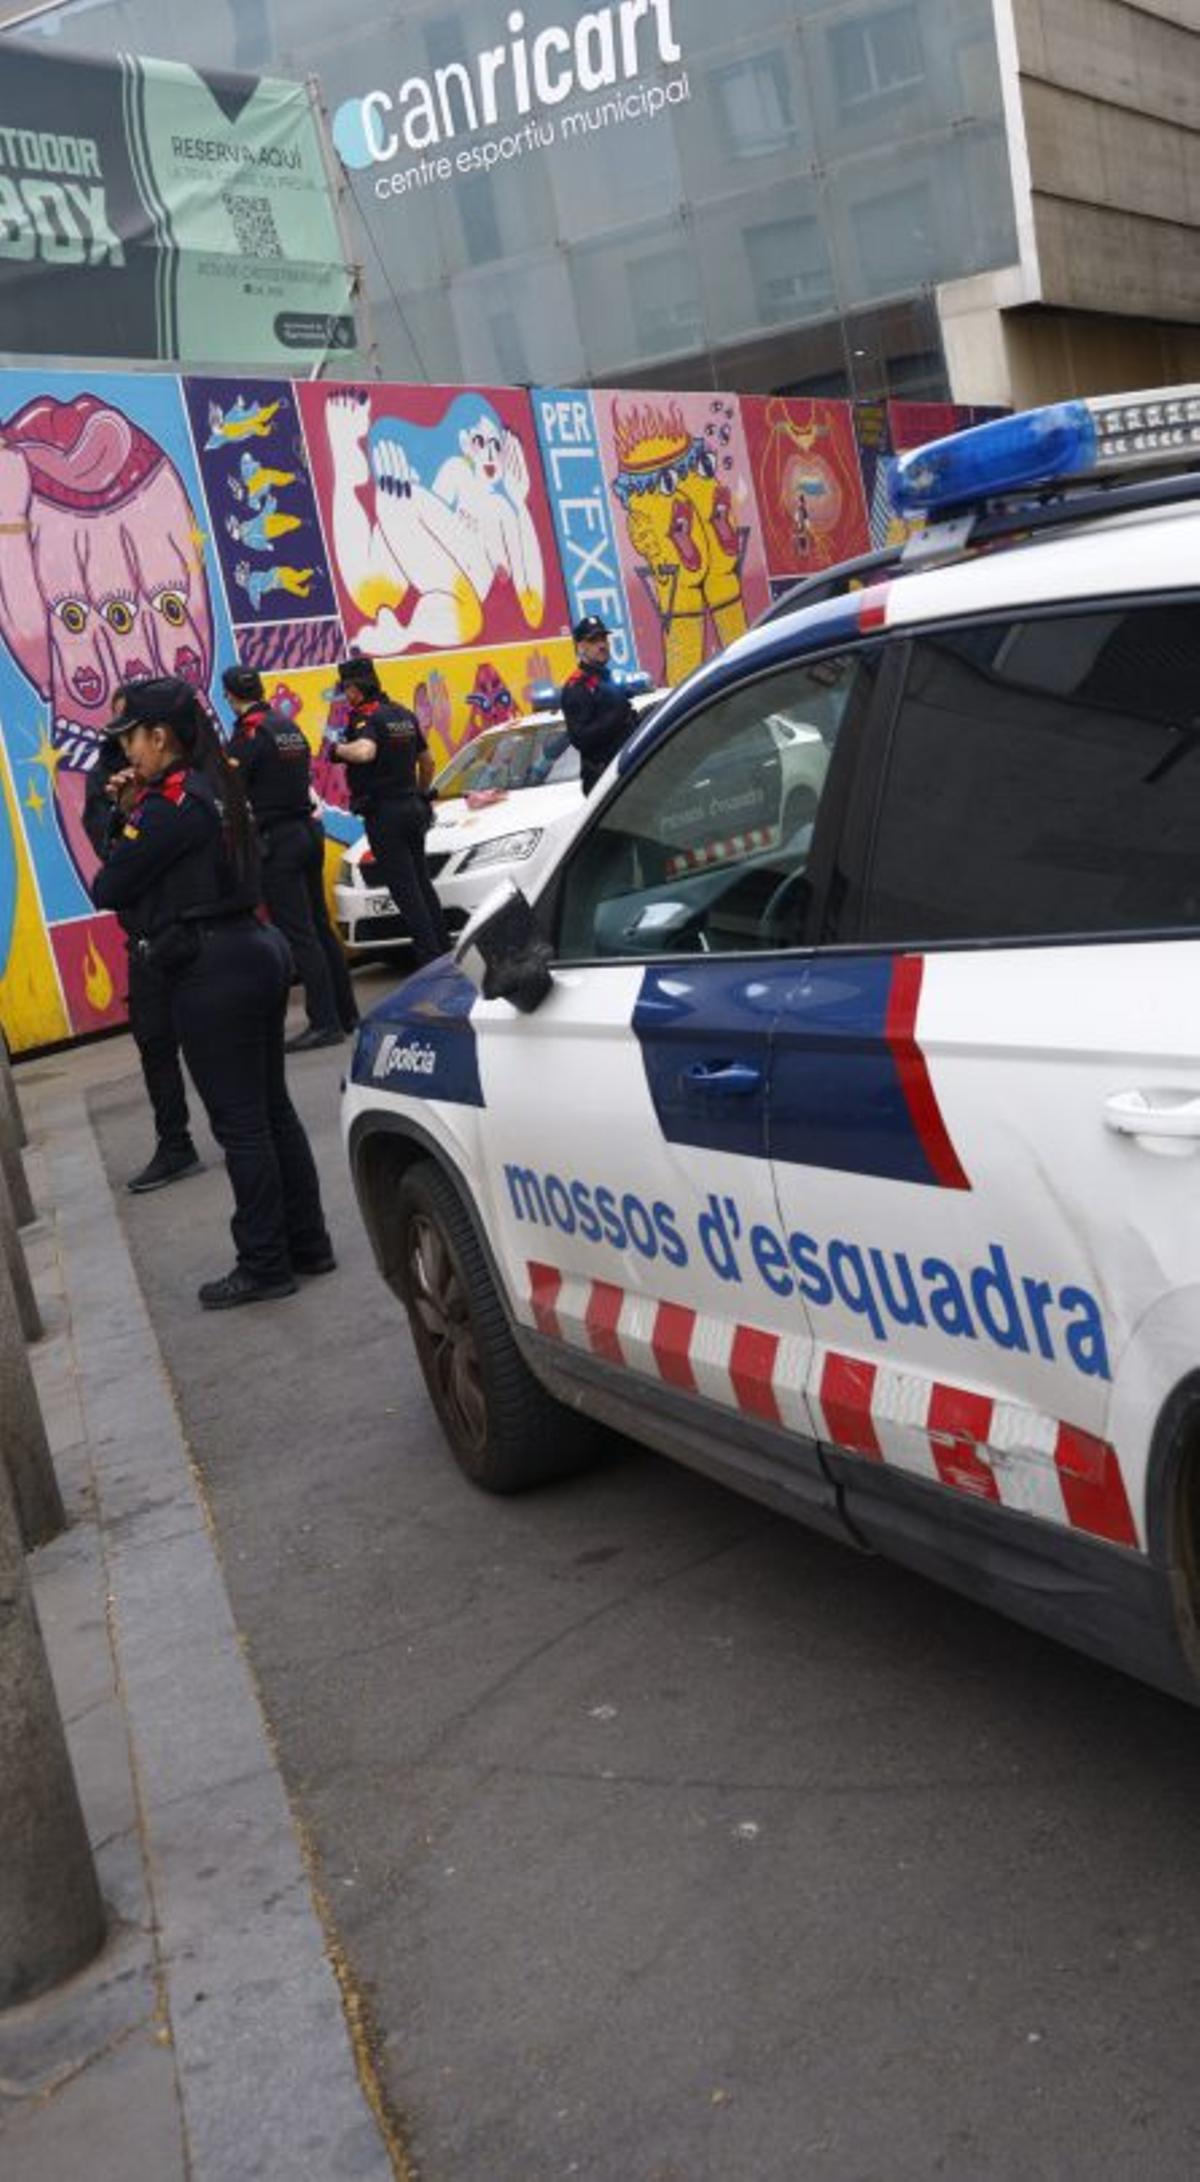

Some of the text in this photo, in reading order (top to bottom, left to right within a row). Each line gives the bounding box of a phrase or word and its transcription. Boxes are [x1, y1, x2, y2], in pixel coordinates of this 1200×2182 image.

[361, 0, 681, 162] canricart
[0, 127, 103, 178] TDOOR
[171, 136, 255, 165] RESERVA
[375, 157, 452, 199] centre
[456, 120, 554, 172] esportiu
[561, 72, 692, 140] municipal
[541, 402, 591, 442] PER
[386, 1041, 437, 1077] policia
[503, 1162, 1113, 1382] mossos d'esquadra
